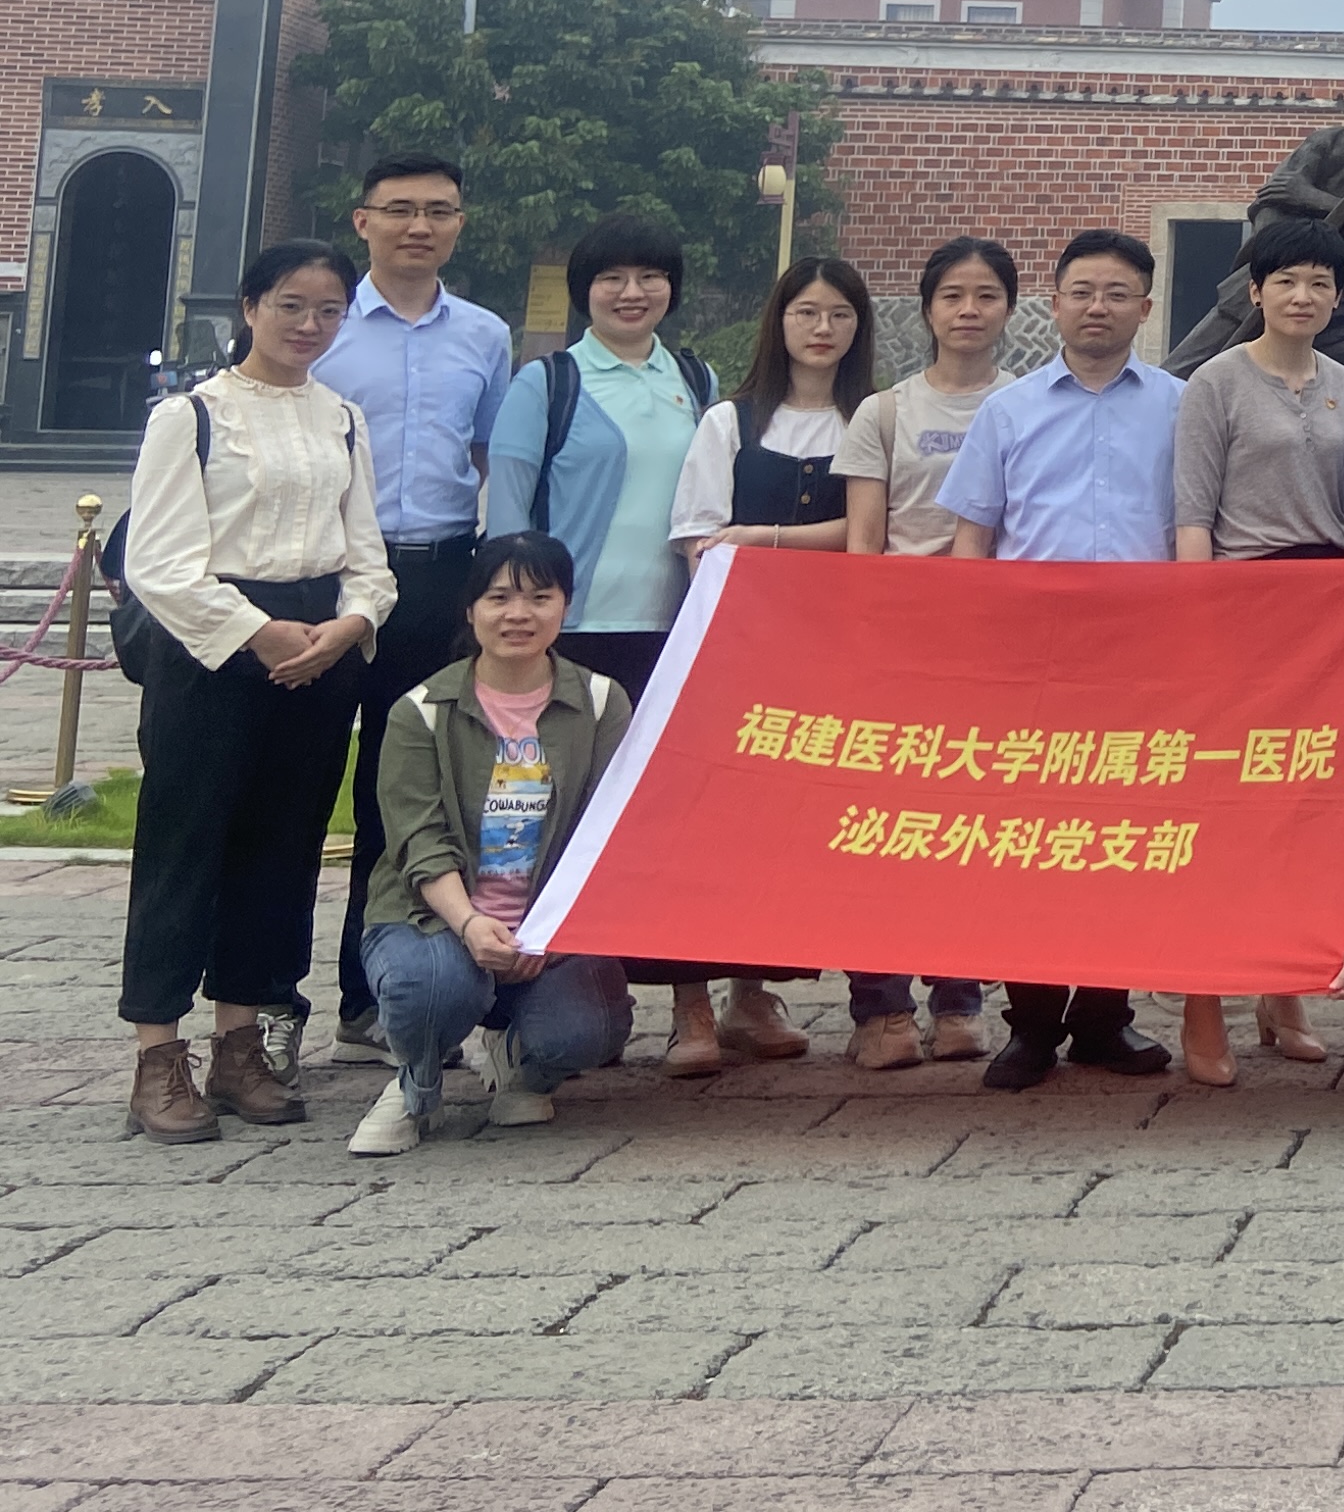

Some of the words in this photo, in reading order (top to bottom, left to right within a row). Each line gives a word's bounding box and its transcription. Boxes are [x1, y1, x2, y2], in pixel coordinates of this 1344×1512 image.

[737, 704, 1338, 786] 福建医科大学附属第一医院
[829, 805, 1199, 874] 泌尿外科党支部
